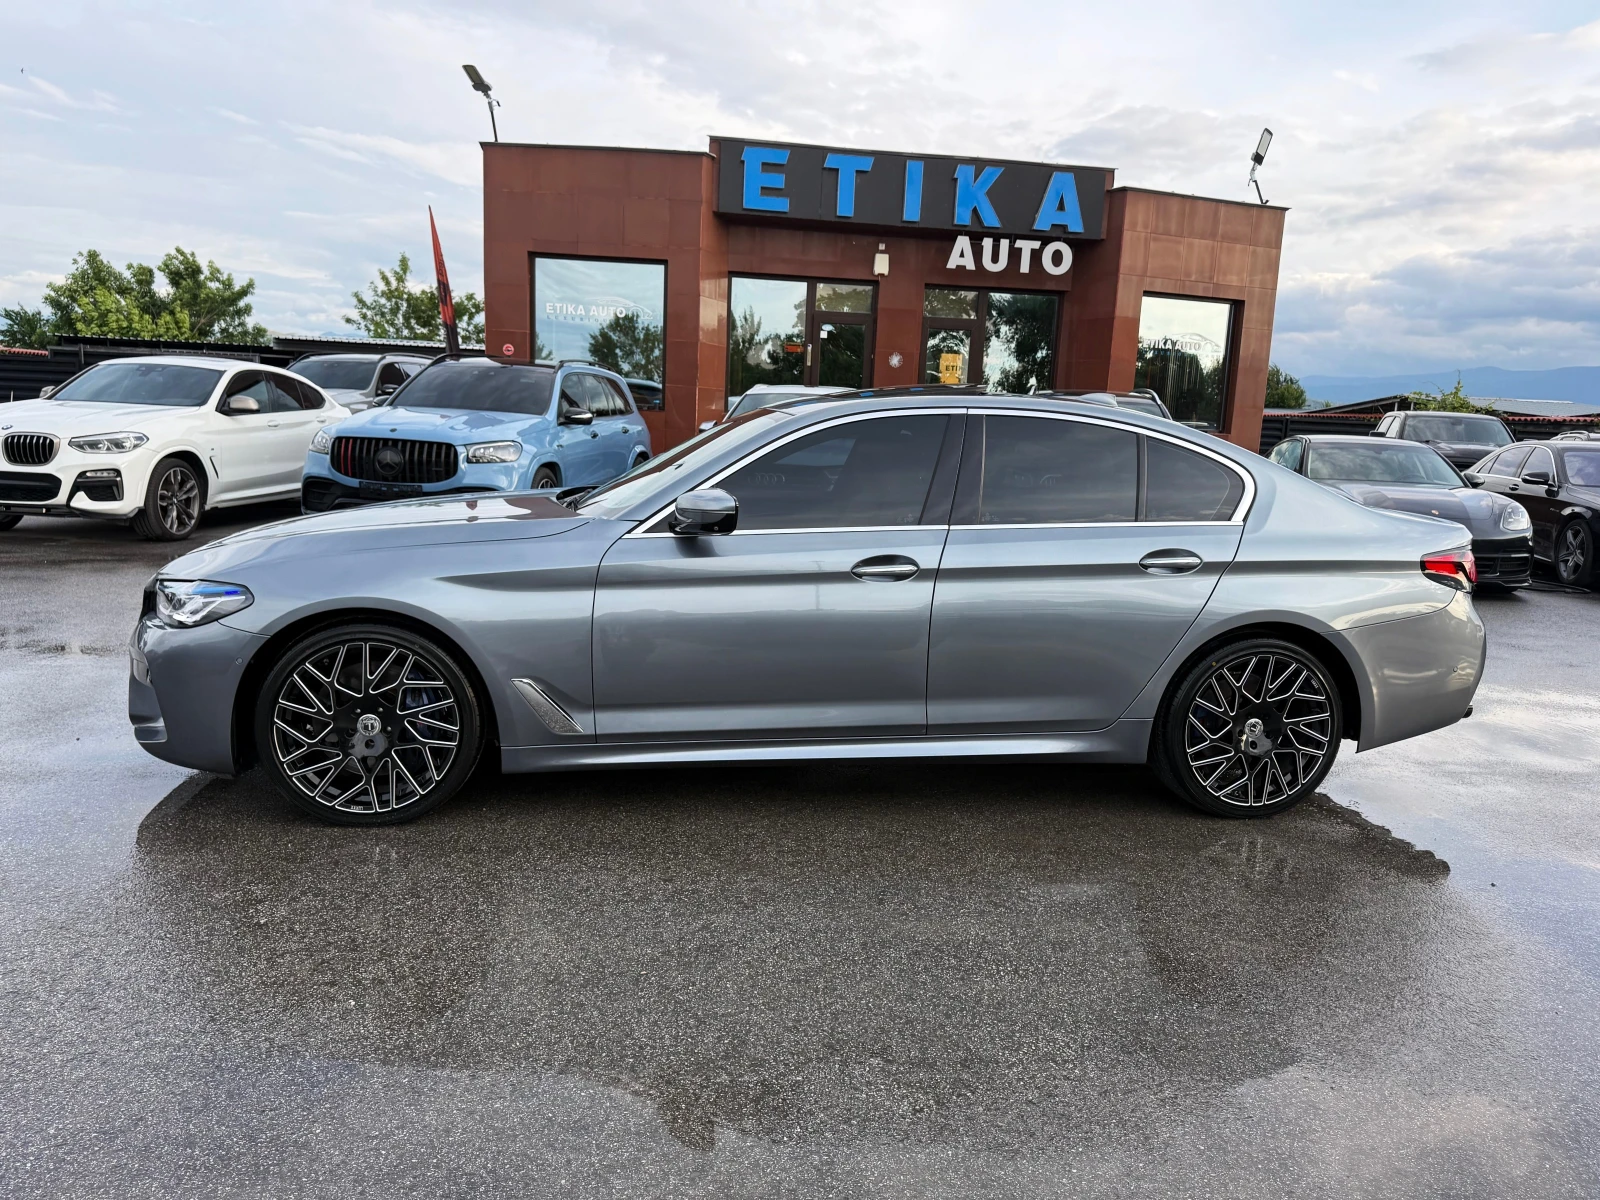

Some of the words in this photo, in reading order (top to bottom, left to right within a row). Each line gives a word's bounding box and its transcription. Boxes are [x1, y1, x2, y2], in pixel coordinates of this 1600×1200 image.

[741, 146, 1084, 233] ETIKA
[946, 235, 1073, 276] AUTO
[546, 302, 586, 316] ETIKA
[590, 305, 626, 318] AUTO
[1143, 338, 1172, 350] ETIKA
[1175, 340, 1202, 351] AUTO
